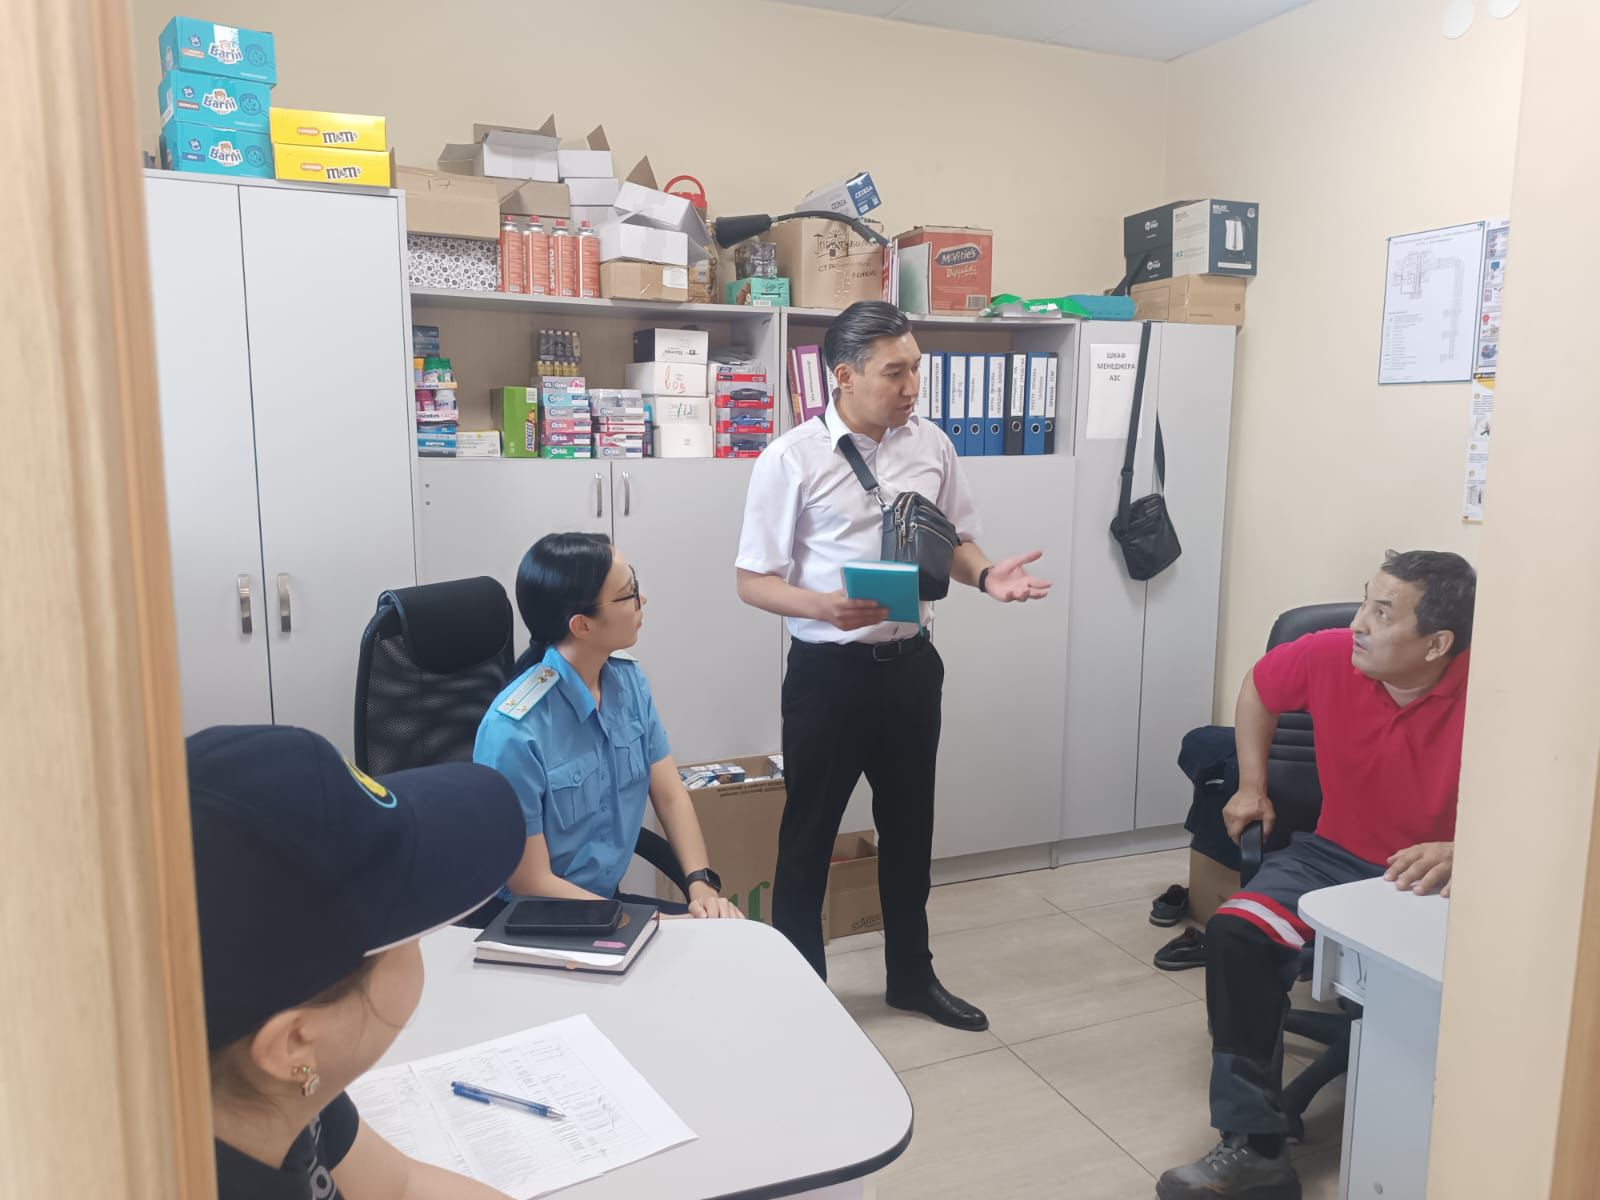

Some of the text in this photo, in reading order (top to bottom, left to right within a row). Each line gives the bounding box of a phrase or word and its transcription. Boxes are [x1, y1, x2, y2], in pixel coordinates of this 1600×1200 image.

[210, 44, 242, 61] Barni
[203, 95, 237, 110] Barni
[210, 147, 242, 162] Barni
